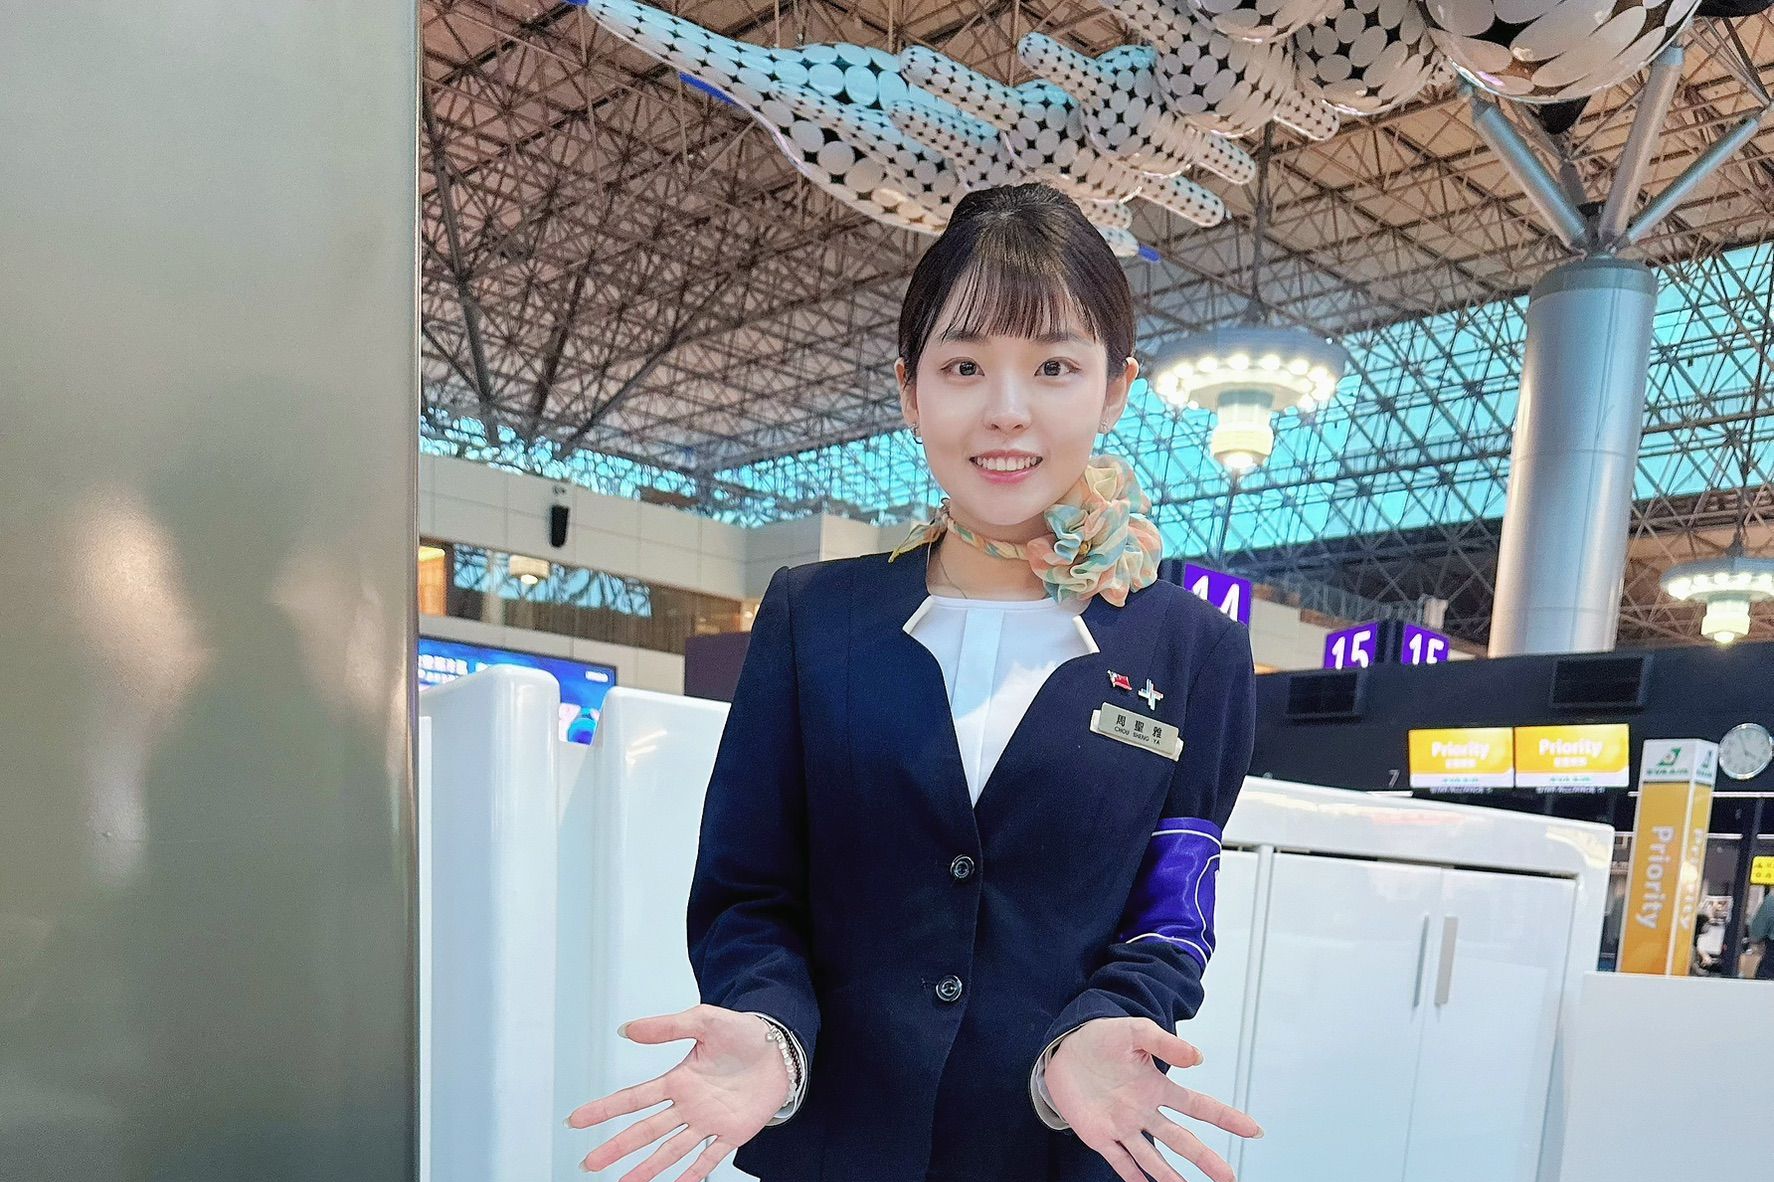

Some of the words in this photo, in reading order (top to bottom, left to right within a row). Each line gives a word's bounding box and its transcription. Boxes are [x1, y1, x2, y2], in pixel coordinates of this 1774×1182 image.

[1332, 630, 1371, 669] 15
[1431, 741, 1490, 760] Priority
[1539, 738, 1604, 757] Priority
[1388, 769, 1400, 787] 7
[1636, 826, 1675, 929] Priority
